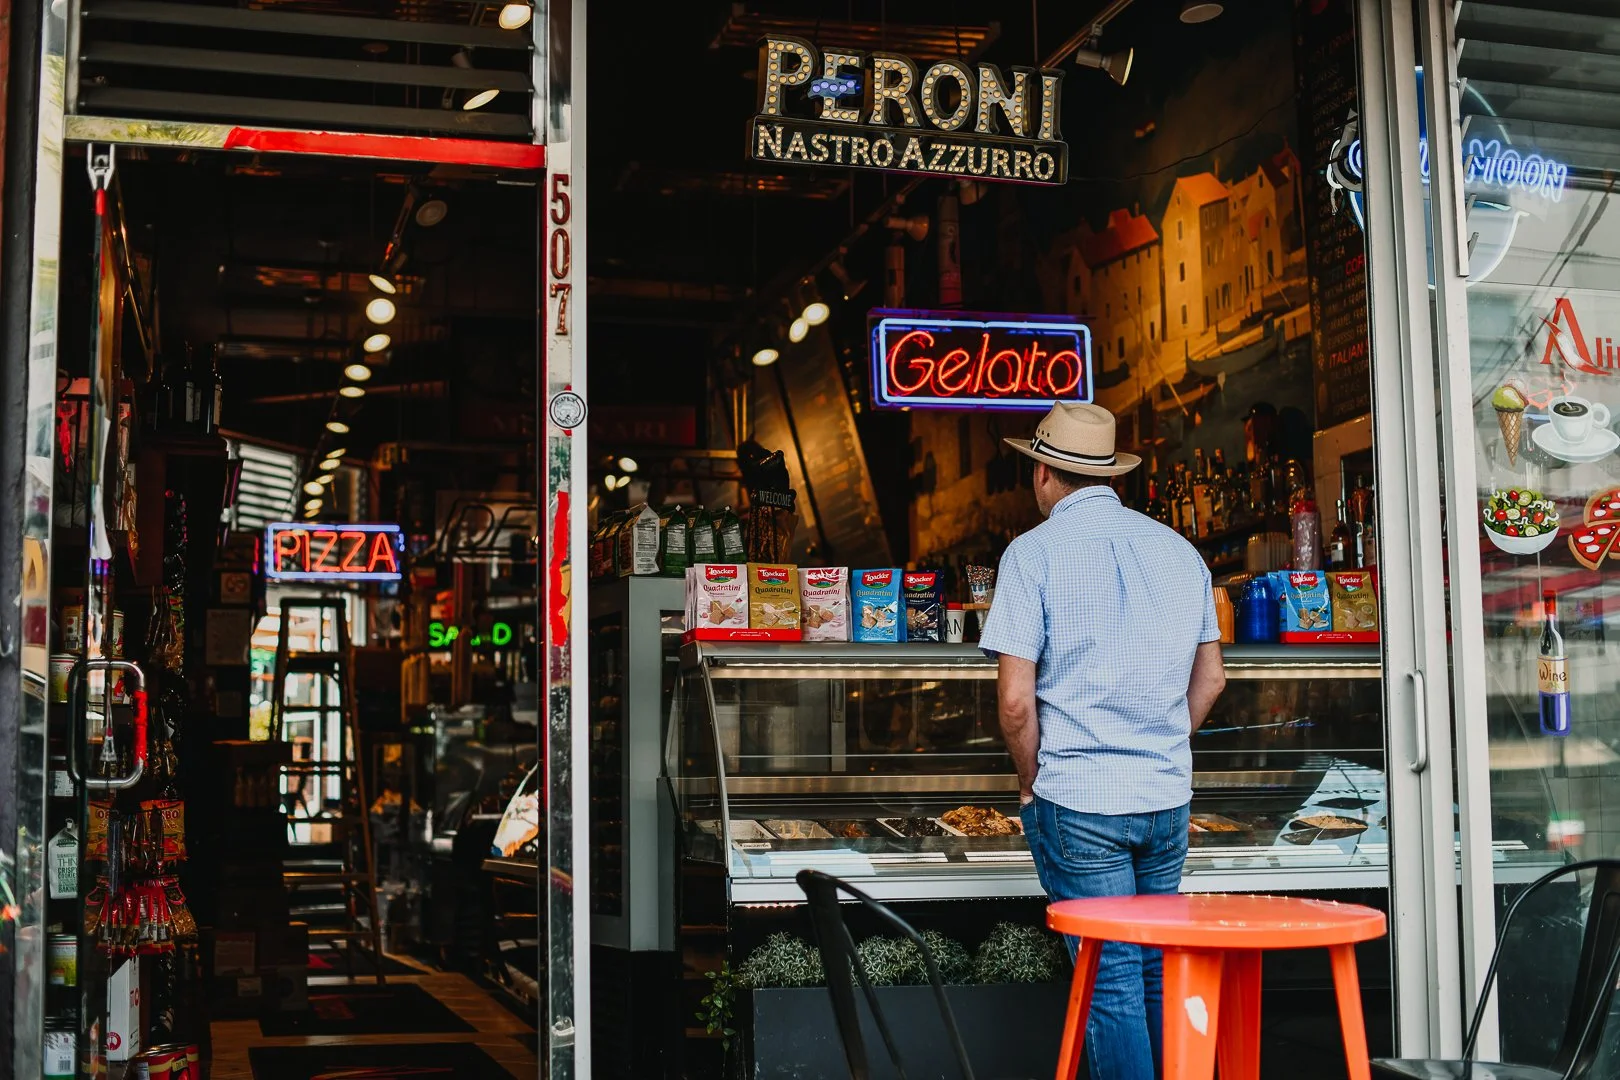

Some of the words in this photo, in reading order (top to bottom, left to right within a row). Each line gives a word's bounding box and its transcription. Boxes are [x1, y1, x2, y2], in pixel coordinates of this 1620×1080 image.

[760, 36, 1064, 141] PERONI
[757, 124, 894, 167] NASTRO
[899, 136, 1055, 180] AZZURRO
[1465, 138, 1567, 203] MOON
[550, 173, 571, 336] 507
[890, 330, 1082, 395] Gelato
[759, 490, 792, 507] WELCOME
[275, 529, 398, 573] PIZZA
[703, 583, 741, 593] Quadratini
[755, 586, 793, 596] Quadratini
[803, 588, 840, 597] Quadratini
[904, 591, 936, 599] uadratini
[428, 620, 513, 648] SAD
[1538, 662, 1567, 682] Wine
